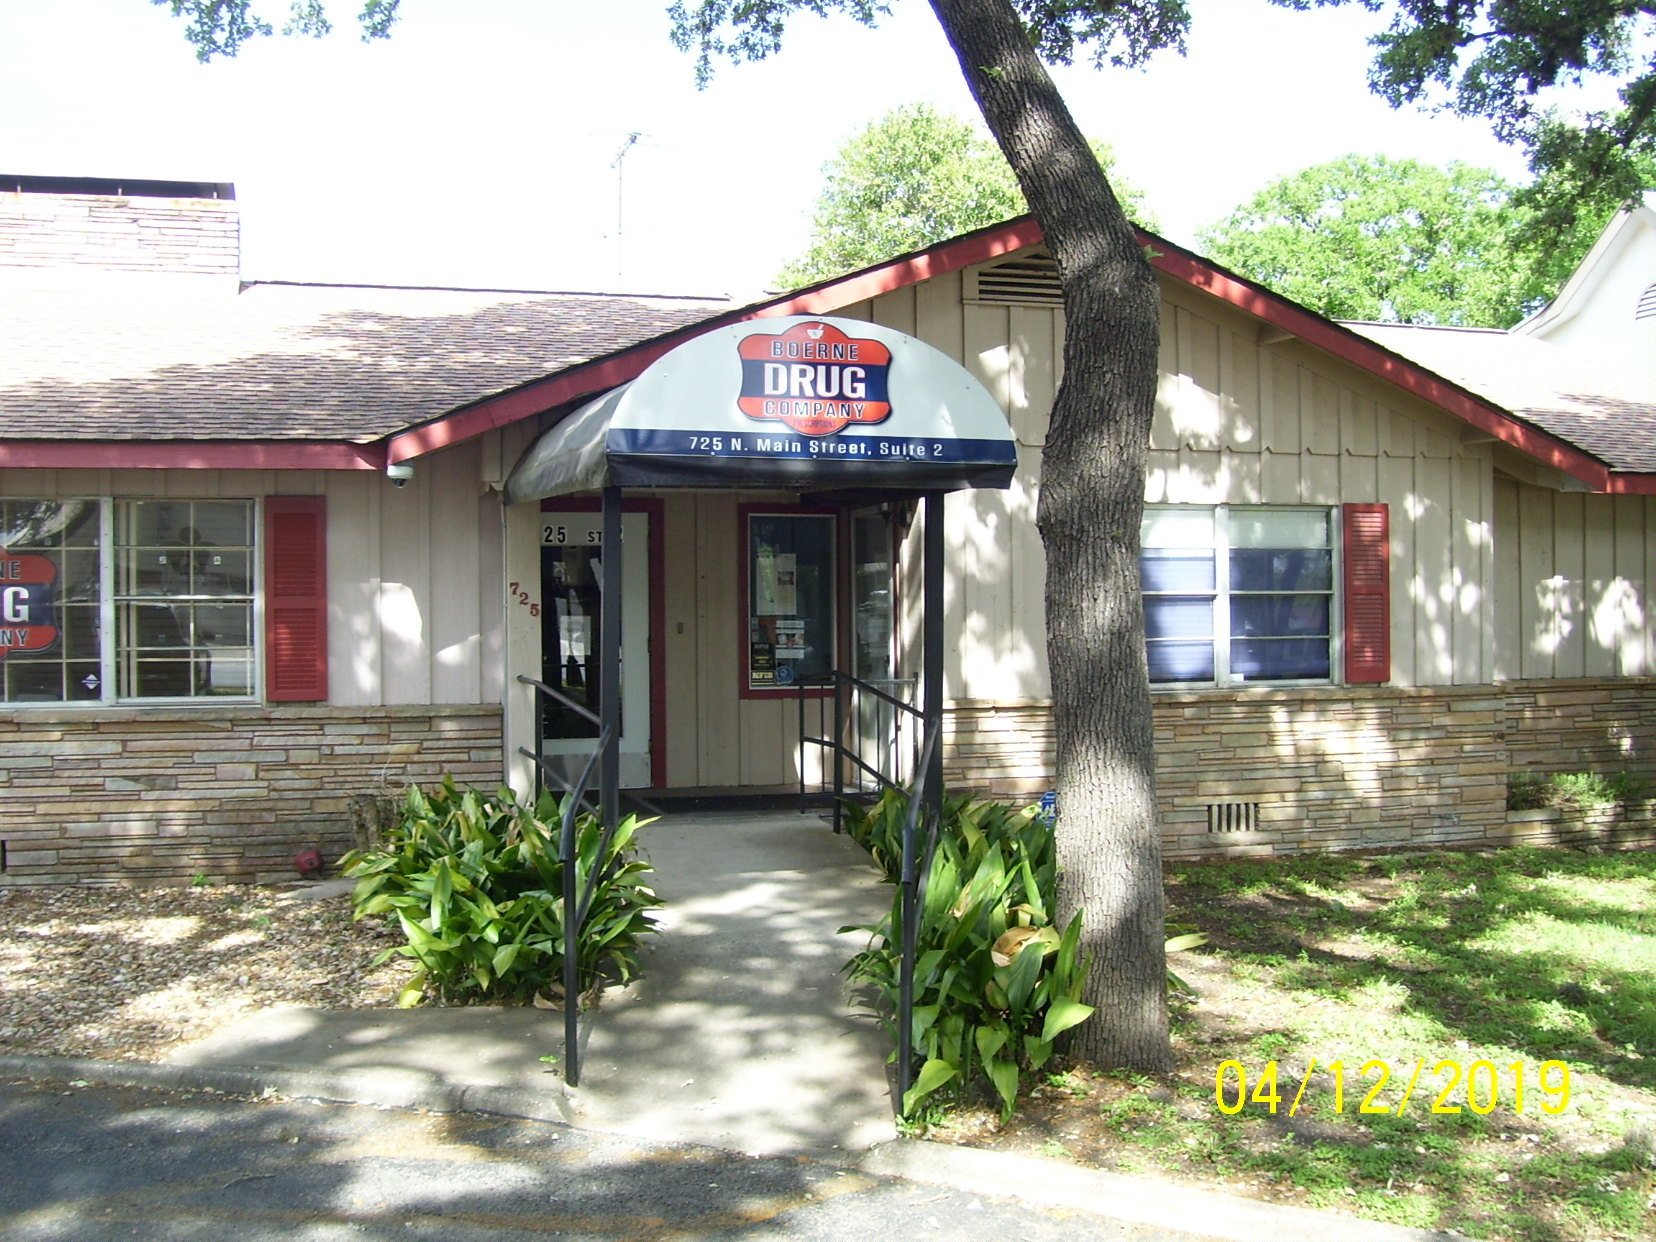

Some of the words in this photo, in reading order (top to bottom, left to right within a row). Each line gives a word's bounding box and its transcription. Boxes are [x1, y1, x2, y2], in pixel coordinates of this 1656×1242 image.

[771, 340, 859, 361] BOERNE
[764, 362, 866, 399] DRUG
[763, 399, 866, 419] COMPANY
[689, 436, 723, 451] 725
[731, 437, 749, 452] N.
[756, 438, 801, 453] Main
[809, 439, 872, 456] Street,
[879, 442, 926, 456] Suite
[933, 443, 943, 456] 2
[510, 582, 540, 617] 725
